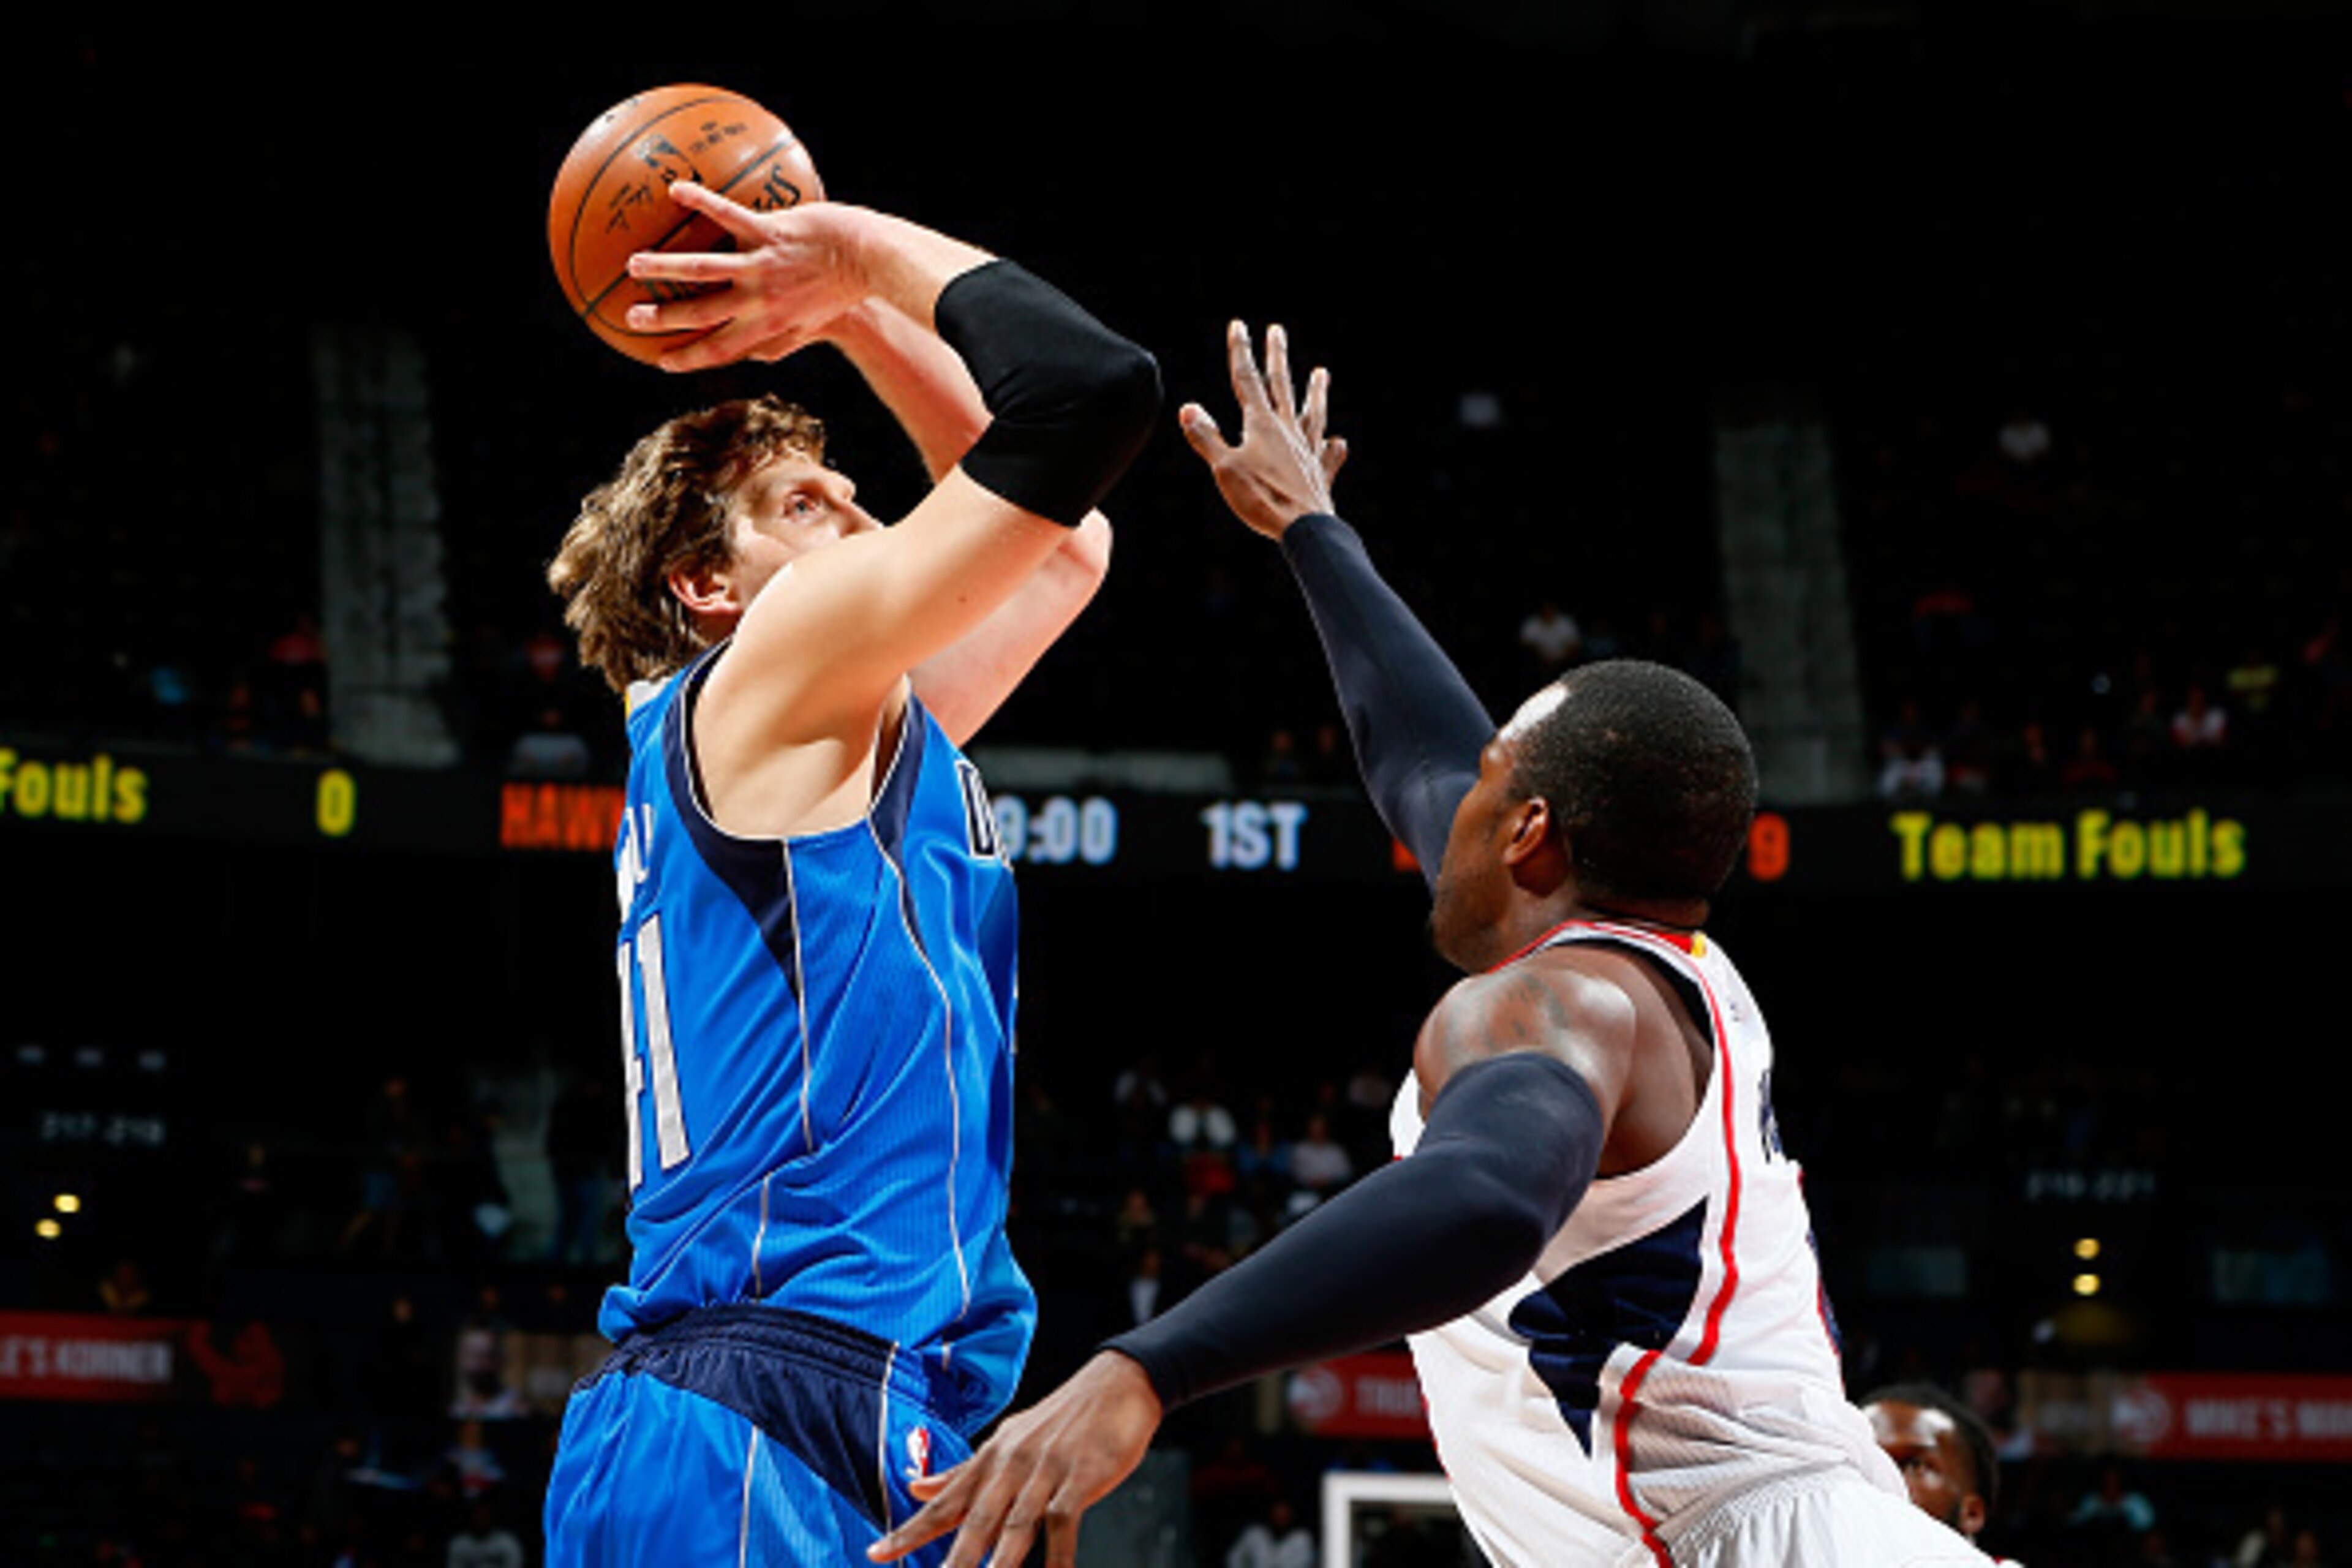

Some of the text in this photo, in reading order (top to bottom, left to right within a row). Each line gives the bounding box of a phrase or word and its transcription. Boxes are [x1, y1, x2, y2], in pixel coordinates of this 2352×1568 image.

[317, 770, 355, 835] 0
[1202, 801, 1308, 870] 1ST
[1891, 809, 2245, 878] Team Fouls
